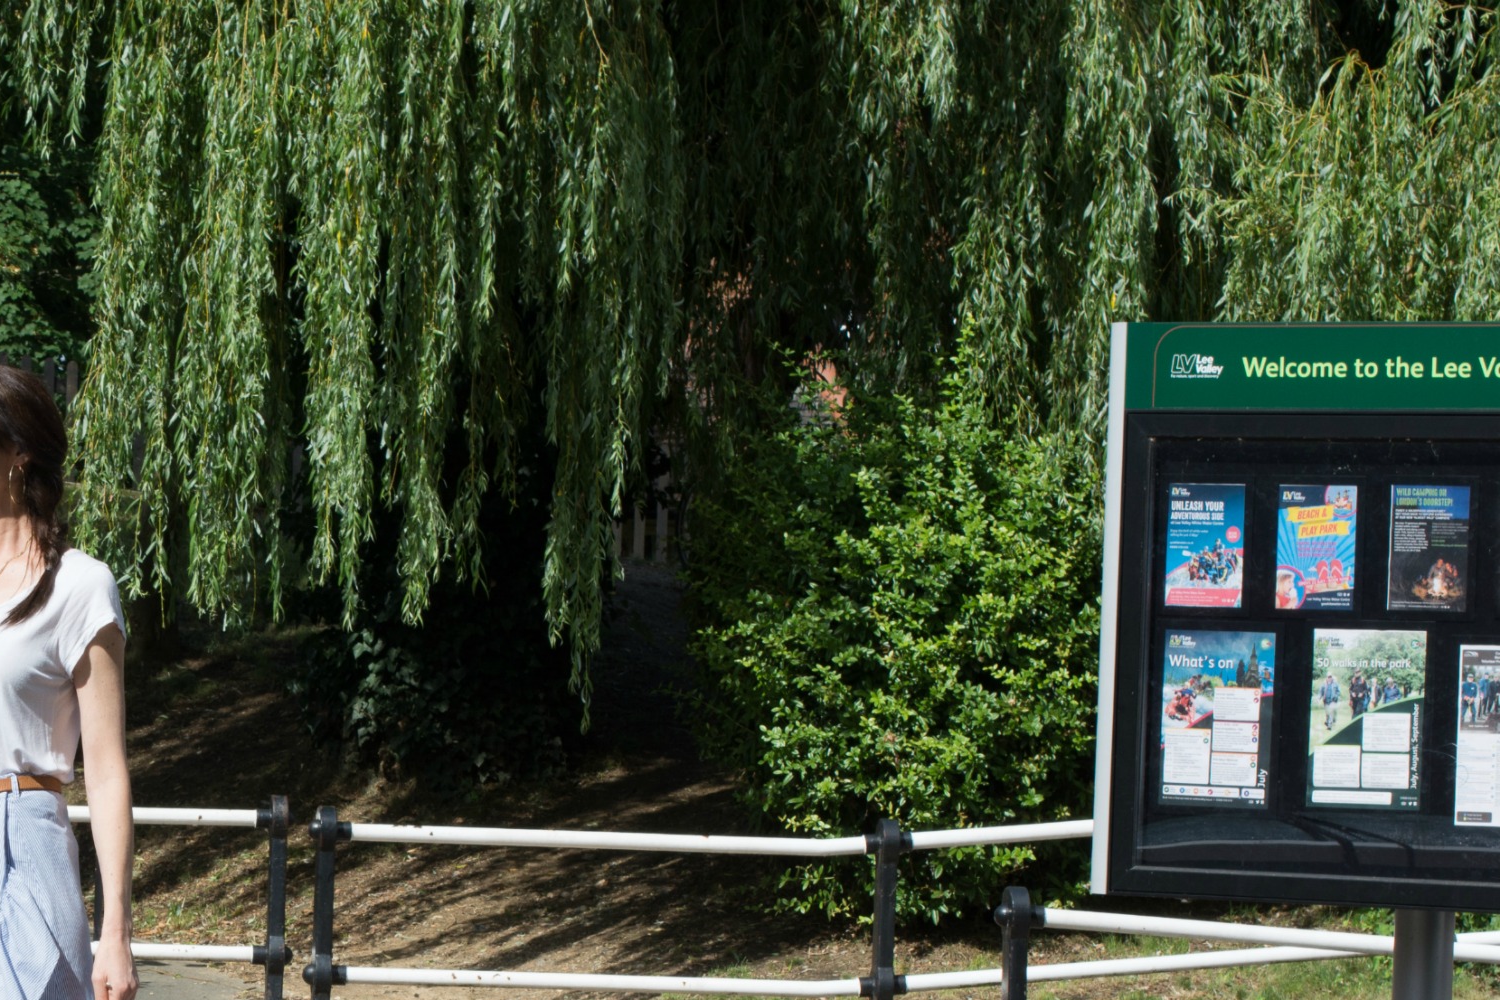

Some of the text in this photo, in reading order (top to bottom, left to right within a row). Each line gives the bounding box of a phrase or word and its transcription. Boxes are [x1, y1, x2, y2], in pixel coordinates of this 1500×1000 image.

[1196, 353, 1214, 364] Lee
[1196, 363, 1224, 375] Valley
[1242, 356, 1348, 378] Welcome
[1354, 358, 1378, 378] to
[1385, 356, 1424, 378] the
[1431, 356, 1472, 378] Lee
[1396, 488, 1412, 496] WILD
[1413, 488, 1438, 497] CAMPING
[1171, 500, 1225, 511] UNLEASH YOUR
[1170, 511, 1225, 521] ADVENTUROUS SIDE
[1297, 508, 1327, 520] BEACH &
[1300, 523, 1338, 536] PLAY PARK
[1169, 654, 1234, 669] What's on
[1317, 658, 1411, 670] 50 walks in the park
[1411, 703, 1420, 743] September
[1411, 744, 1419, 771] August,
[1257, 769, 1268, 788] July
